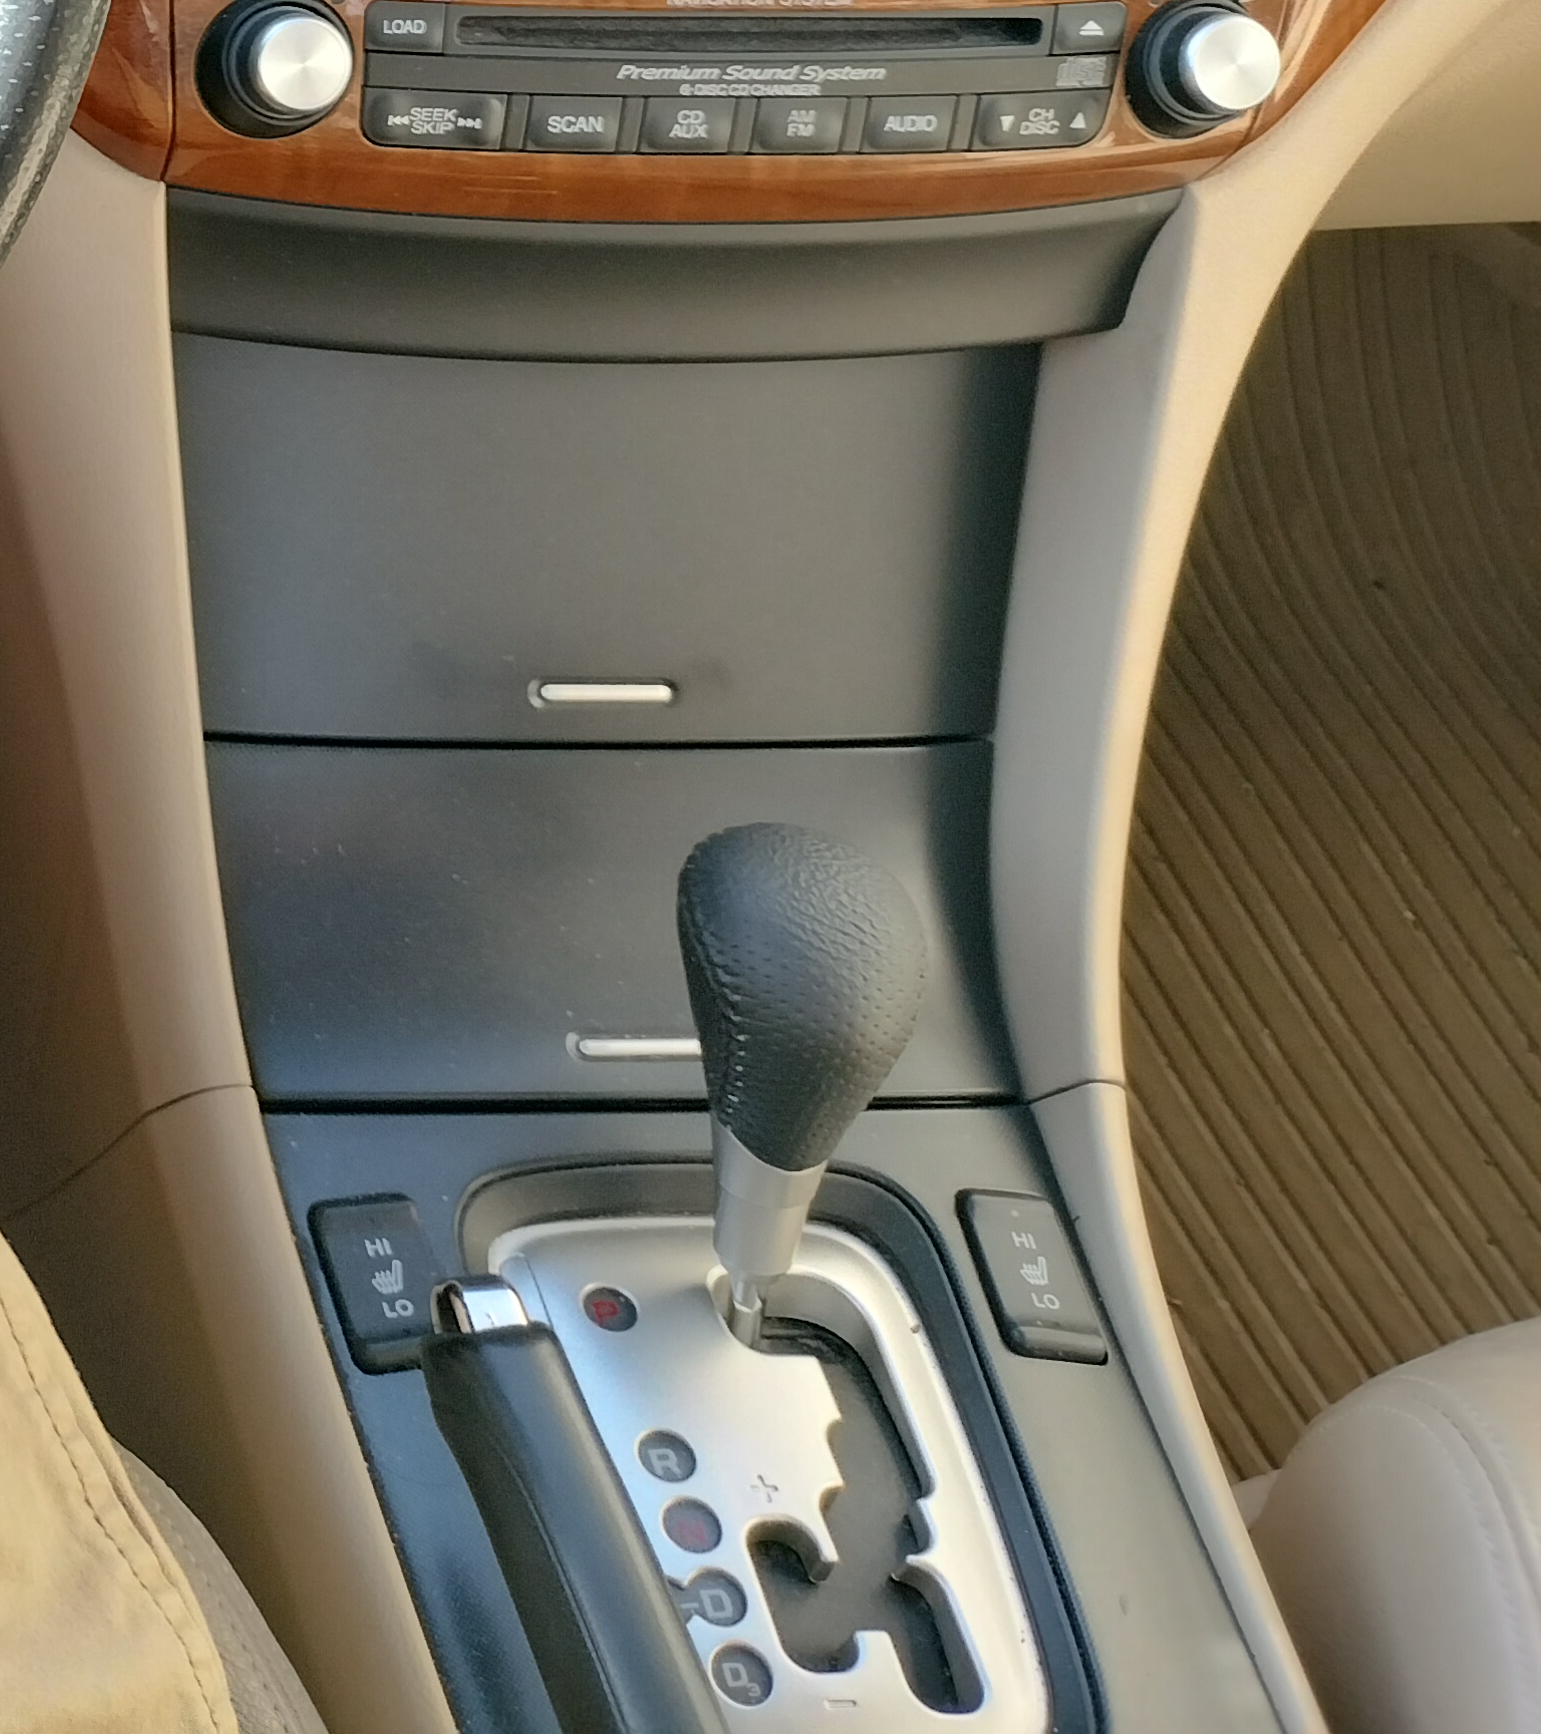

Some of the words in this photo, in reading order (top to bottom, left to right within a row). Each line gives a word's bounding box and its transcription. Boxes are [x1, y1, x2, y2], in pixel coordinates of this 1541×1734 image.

[383, 19, 426, 35] LOAD
[617, 64, 716, 81] Premium
[720, 64, 797, 81] Sound
[800, 64, 887, 84] System
[409, 107, 457, 122] SEEK
[677, 110, 706, 124] CD
[1029, 108, 1055, 122] CH
[410, 120, 455, 134] SKIP
[547, 115, 604, 134] SCAN
[669, 123, 708, 139] AUX
[787, 123, 815, 138] FM
[884, 115, 938, 133] AUDIO
[1020, 120, 1061, 135] DISC
[364, 1237, 393, 1259] HI
[1011, 1230, 1039, 1252] HI
[381, 1298, 415, 1319] LO
[1029, 1291, 1060, 1311] LO
[590, 1300, 619, 1327] P
[647, 1447, 682, 1478] R
[699, 1588, 733, 1619] D
